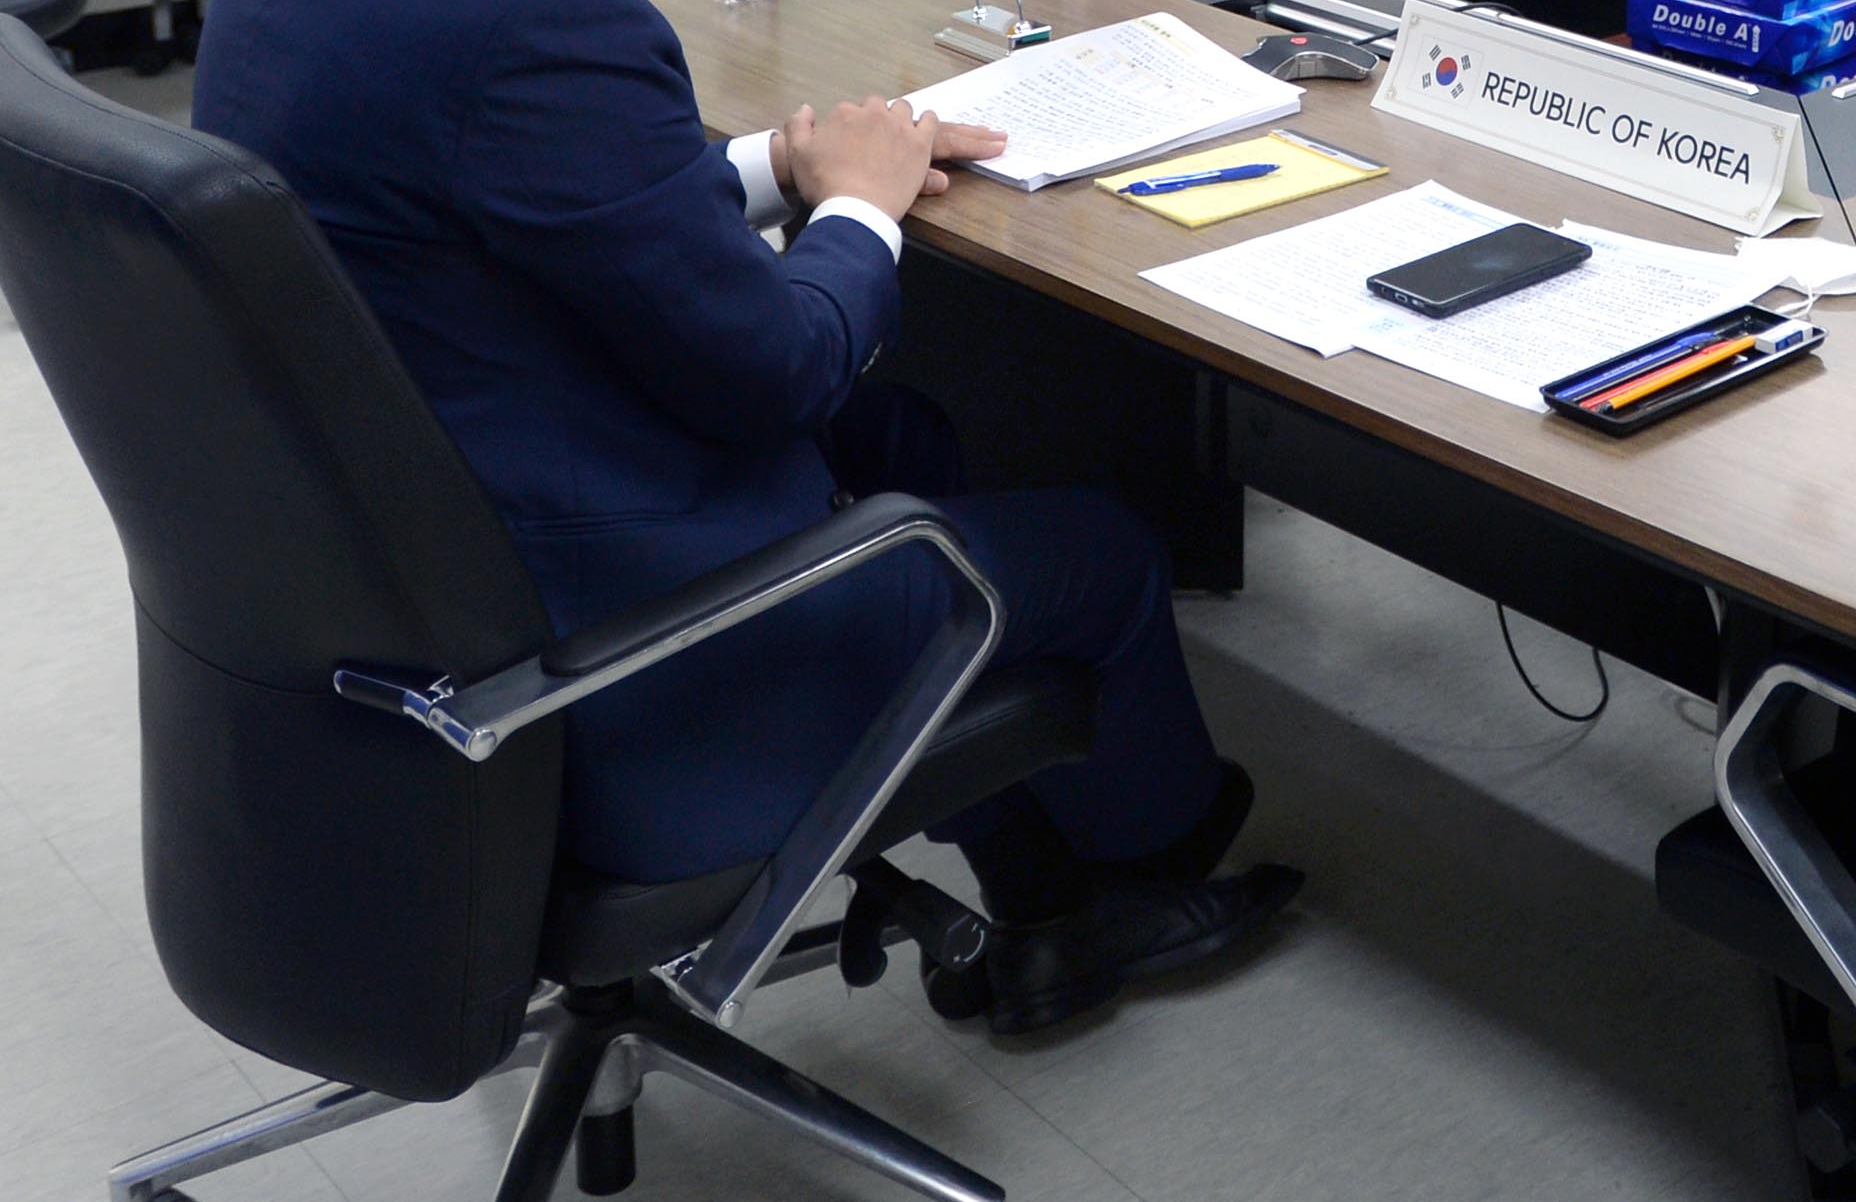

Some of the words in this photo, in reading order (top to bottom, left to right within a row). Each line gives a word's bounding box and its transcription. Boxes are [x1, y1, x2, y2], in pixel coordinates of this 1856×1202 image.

[1652, 3, 1727, 36] Double
[1733, 22, 1748, 42] A
[1481, 70, 1607, 136] REPUBLIC
[1611, 113, 1653, 149] OF
[1656, 126, 1753, 186] KOREA
